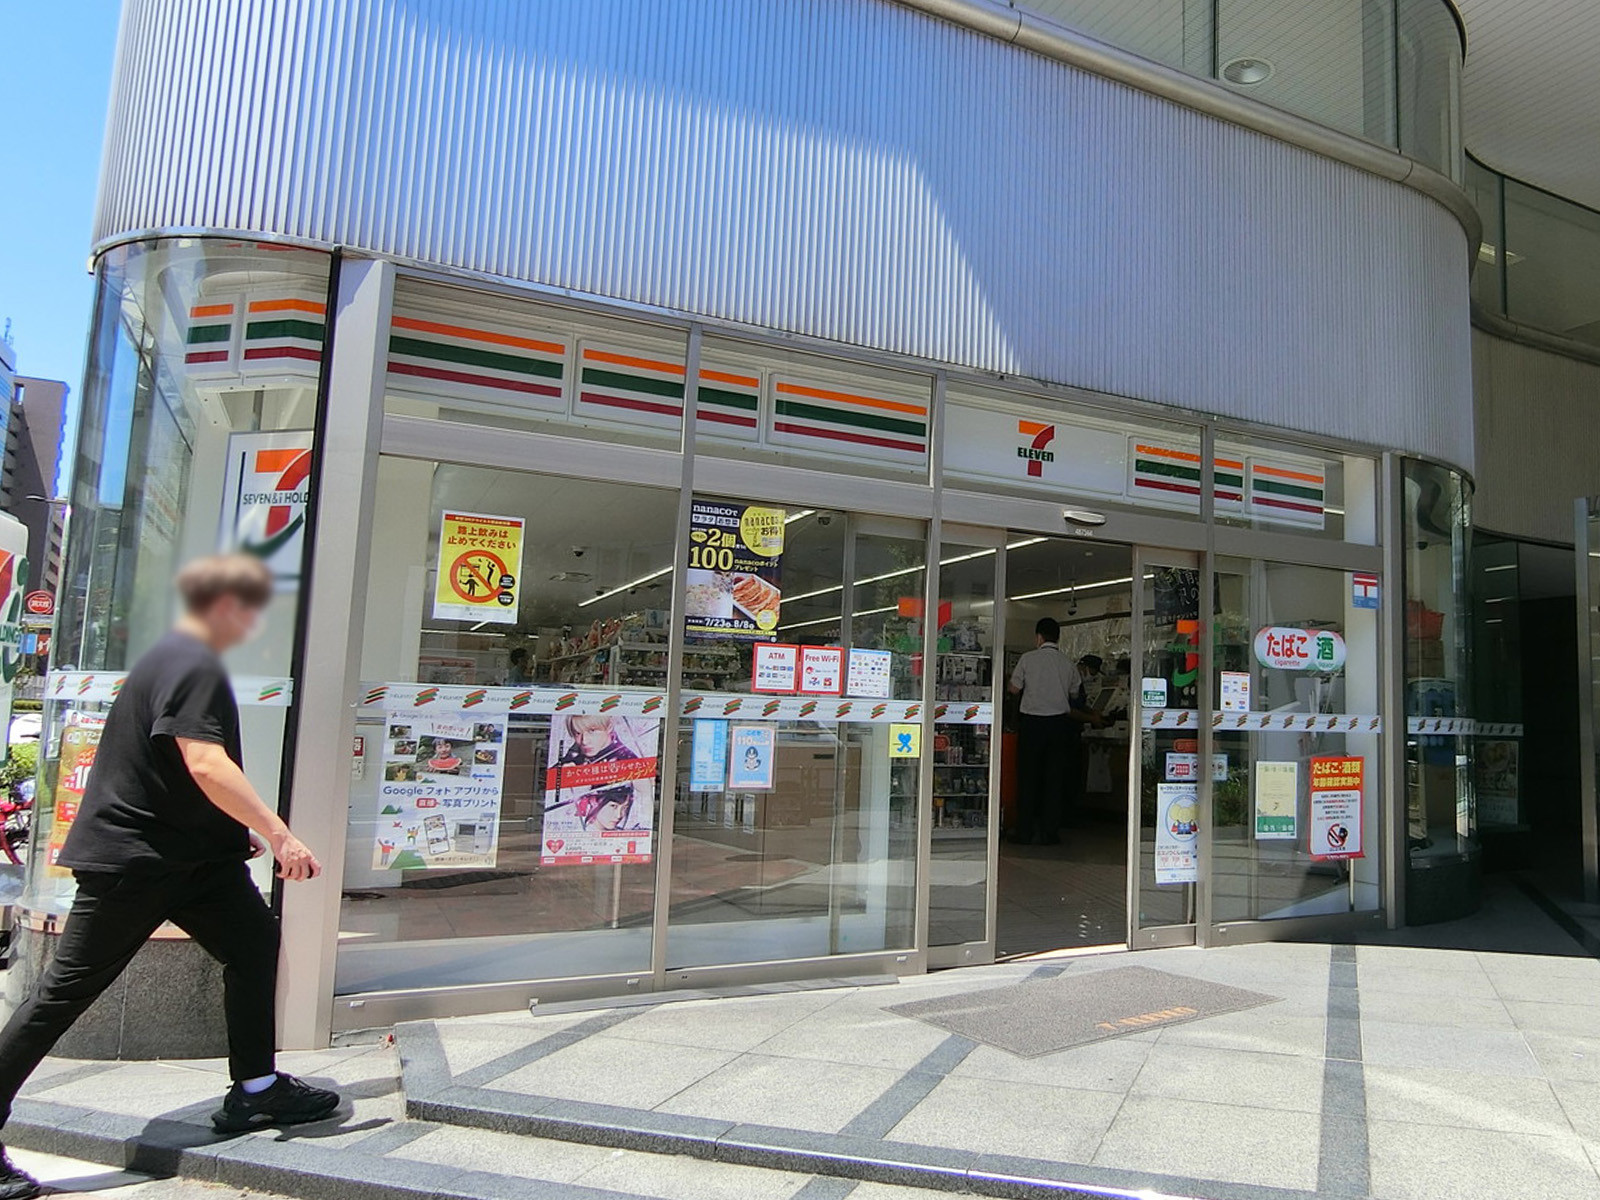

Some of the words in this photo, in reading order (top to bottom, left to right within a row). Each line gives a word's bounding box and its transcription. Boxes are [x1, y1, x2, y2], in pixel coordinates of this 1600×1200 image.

[447, 535, 517, 550] 止めてください
[690, 546, 734, 570] 100
[1266, 632, 1309, 659] たばこ
[1316, 636, 1334, 661] 酒
[768, 652, 786, 660] ATM
[804, 654, 820, 662] Free
[821, 655, 839, 663] Wi-Fi
[383, 785, 423, 797] Google
[426, 786, 451, 796] フォト
[454, 786, 499, 796] アプリから
[442, 798, 498, 809] 写真プリント
